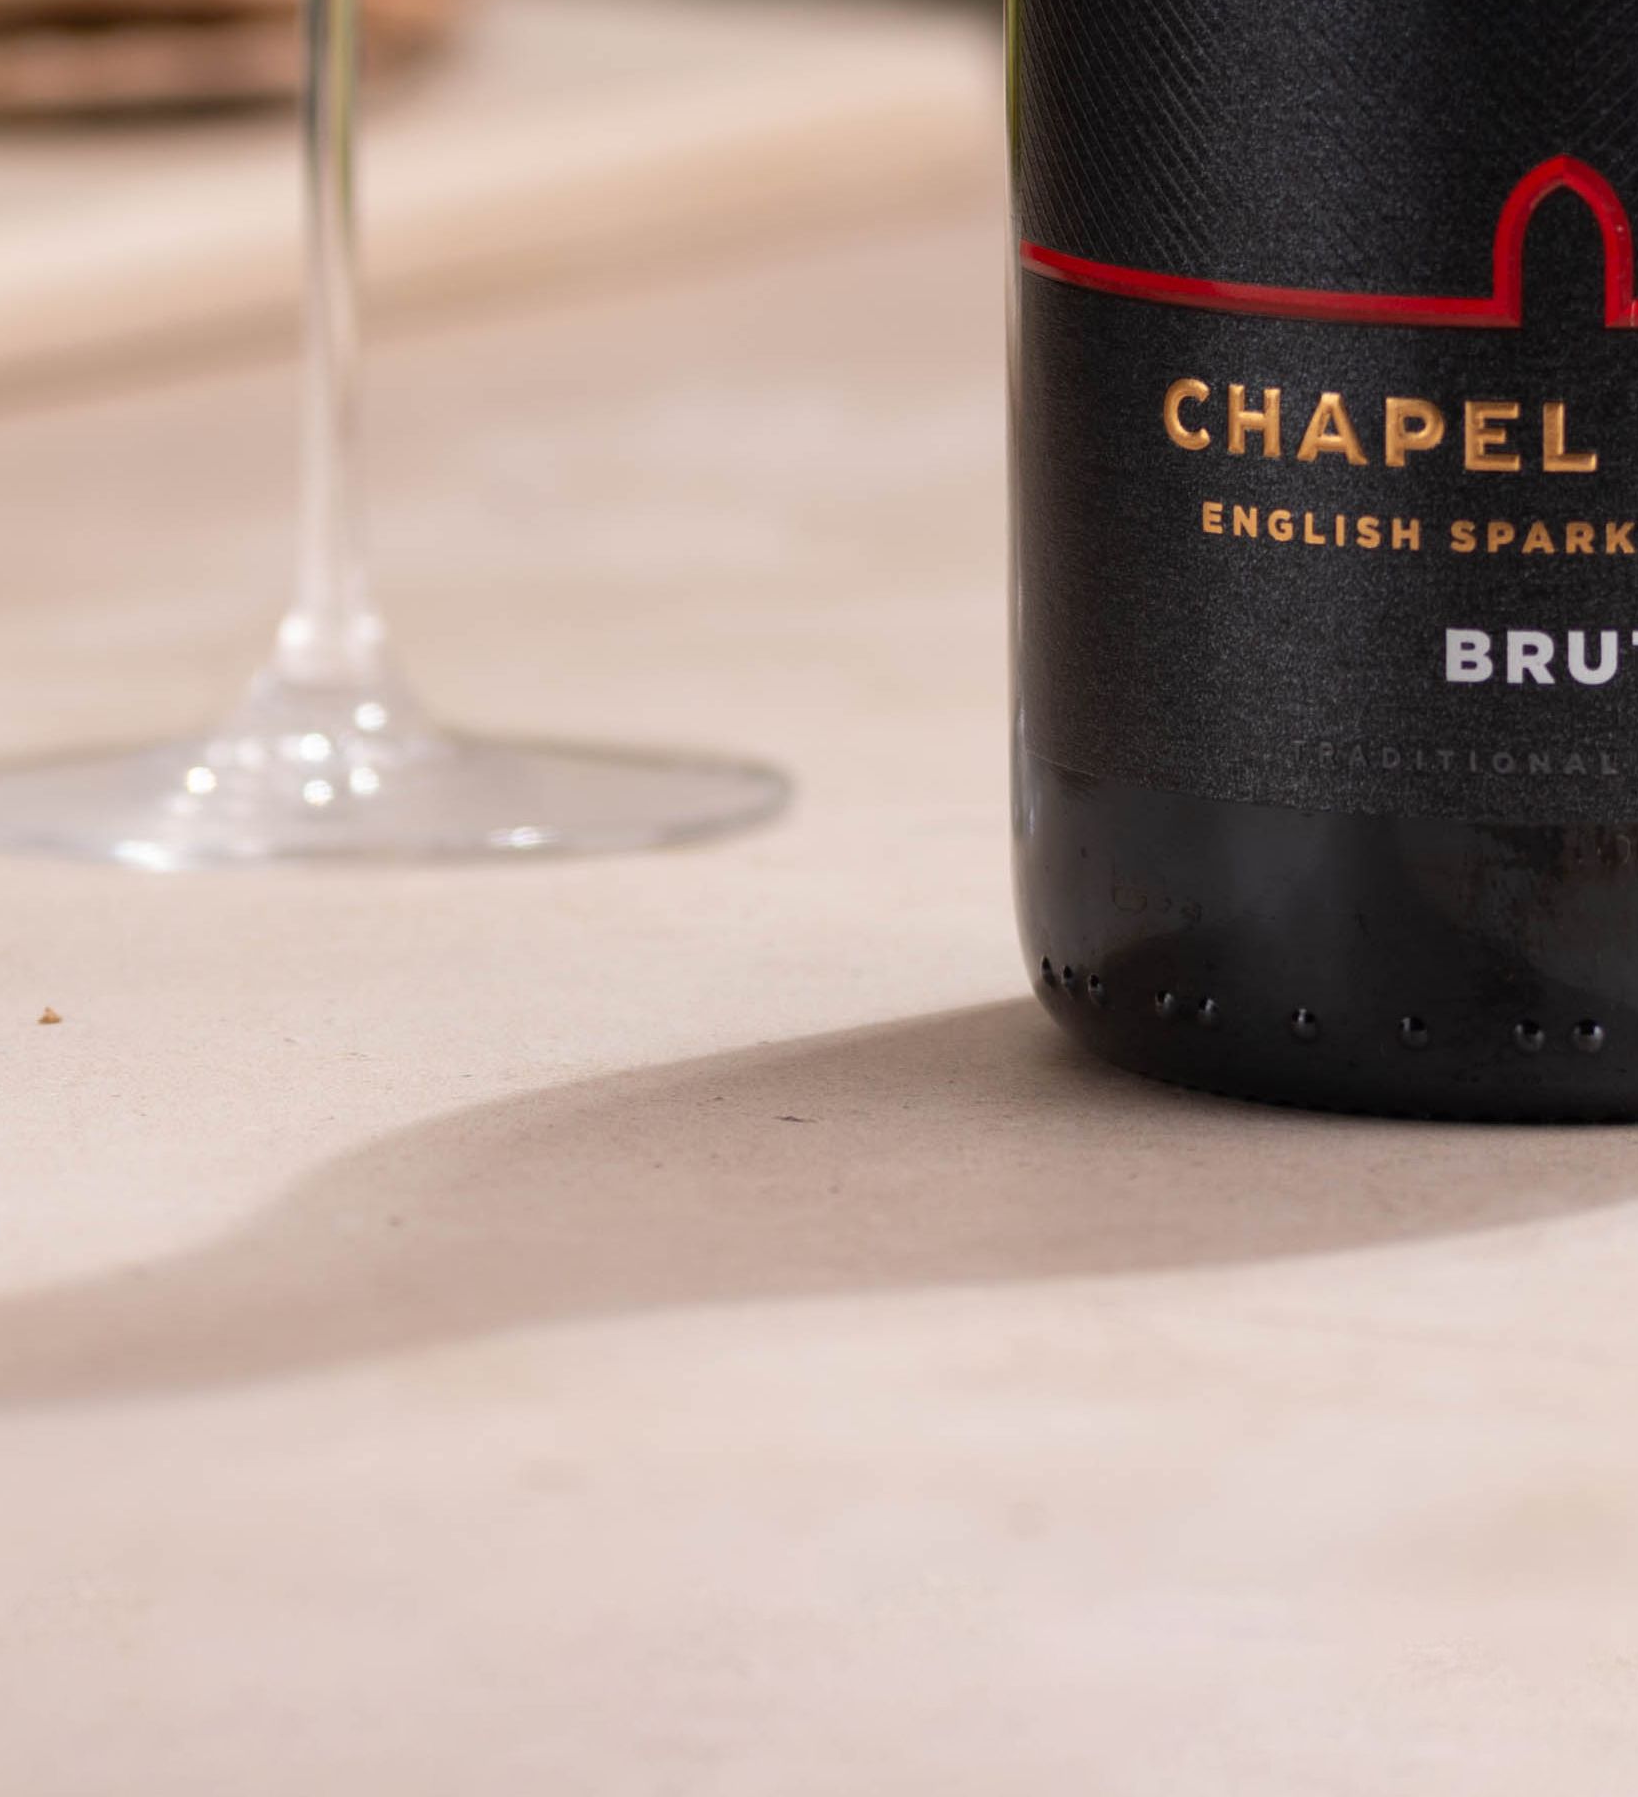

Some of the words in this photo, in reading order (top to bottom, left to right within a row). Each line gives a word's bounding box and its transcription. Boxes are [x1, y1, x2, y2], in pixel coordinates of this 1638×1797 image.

[1163, 377, 1599, 474] CHAPEL
[1201, 502, 1421, 552] ENGLISH
[1291, 739, 1619, 776] TRADITIONAL
